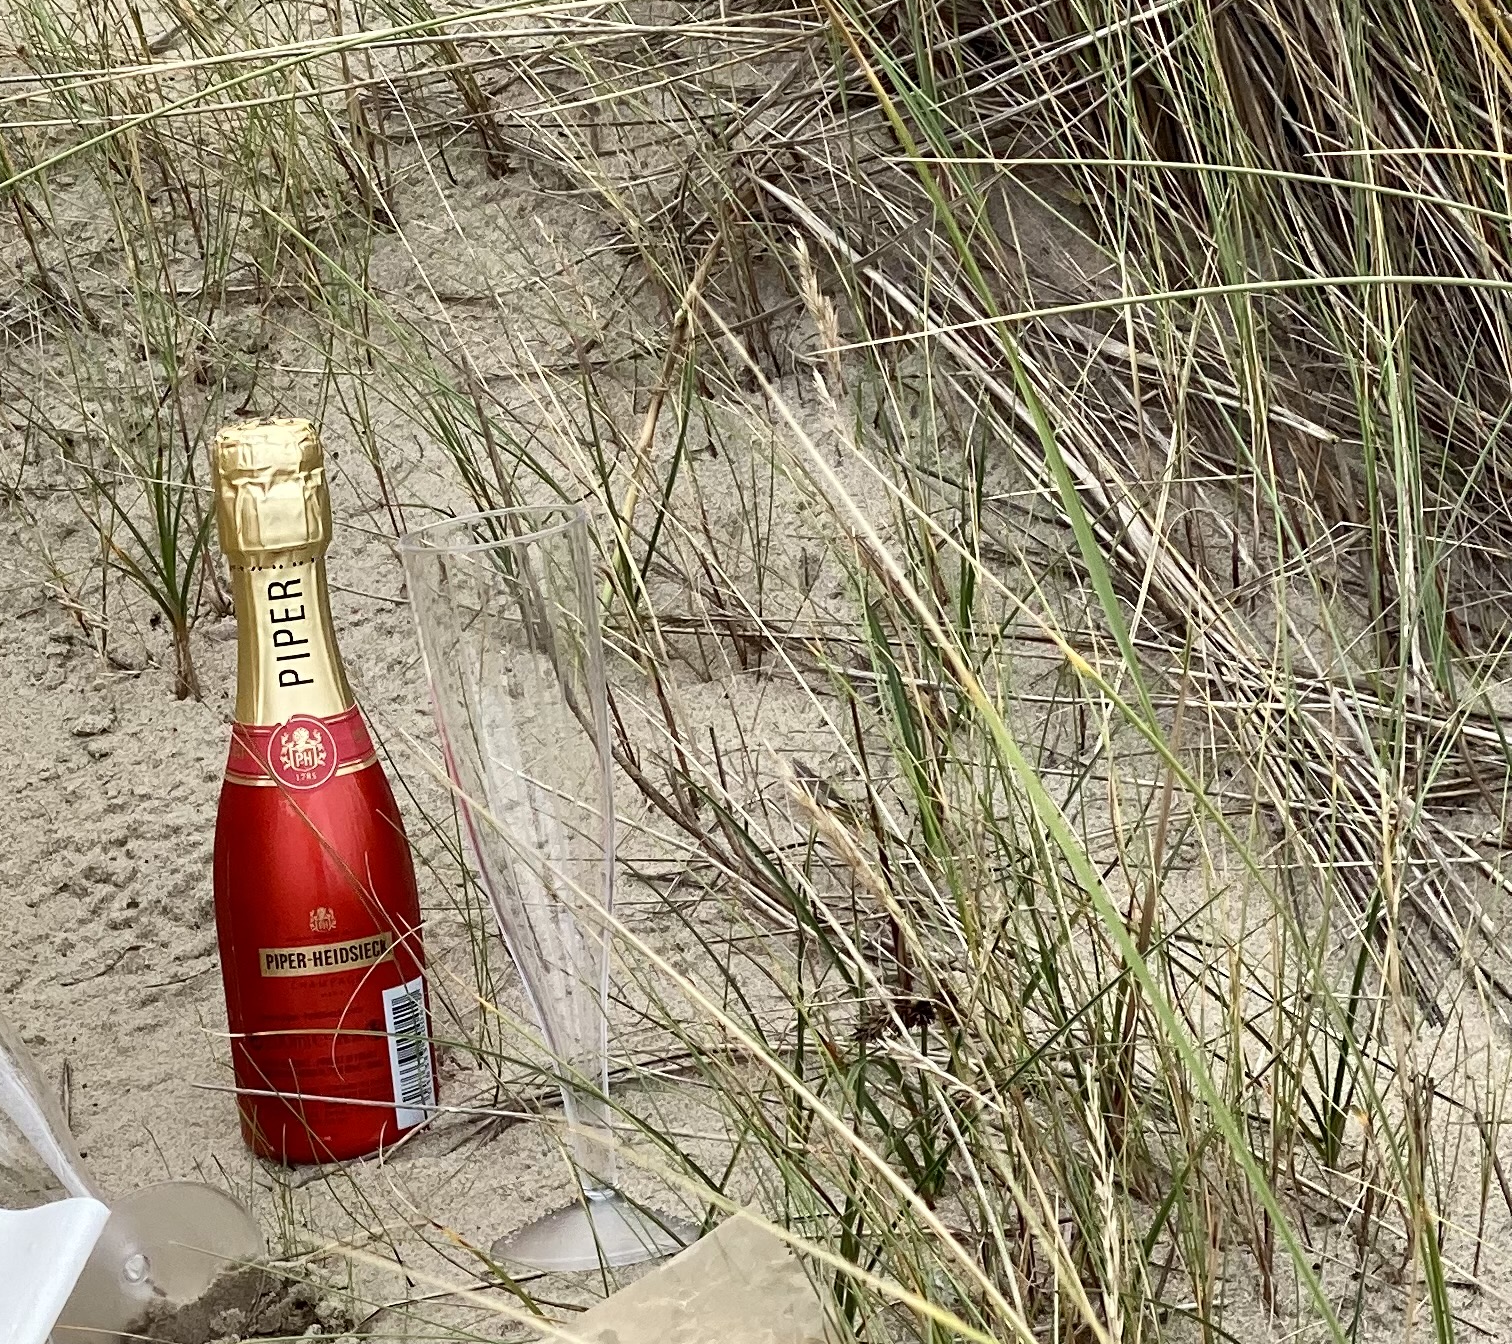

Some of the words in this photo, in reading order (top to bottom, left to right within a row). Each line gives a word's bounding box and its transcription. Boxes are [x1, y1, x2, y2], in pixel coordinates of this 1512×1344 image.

[267, 577, 314, 688] PIPER
[295, 751, 313, 767] PH
[265, 939, 390, 970] PIPER-HEIDSIECK
